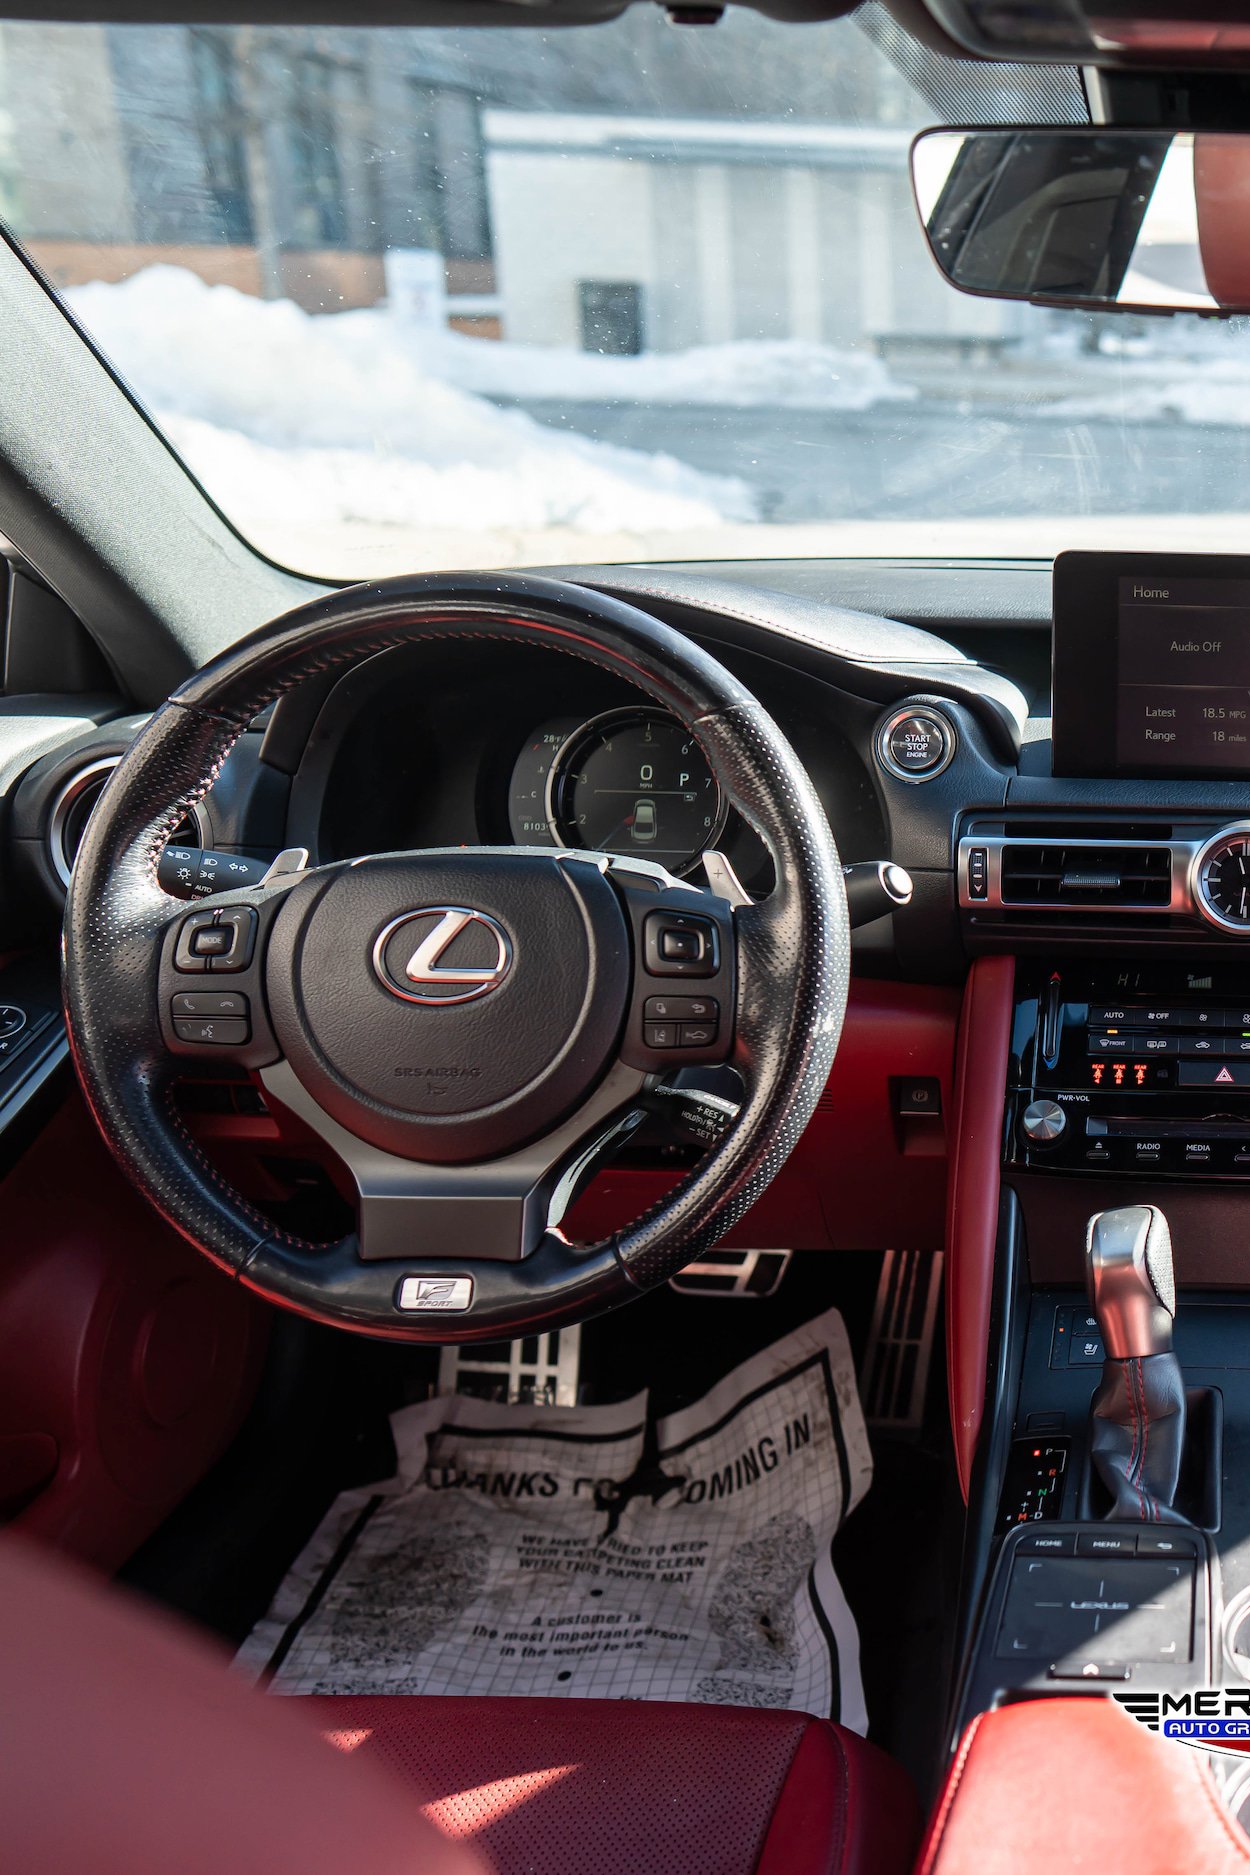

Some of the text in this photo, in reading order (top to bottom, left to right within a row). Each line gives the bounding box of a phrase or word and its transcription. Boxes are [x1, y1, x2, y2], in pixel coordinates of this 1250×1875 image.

[1133, 585, 1169, 598] Home
[1170, 641, 1221, 652] Audio Off
[1145, 706, 1247, 719] Latest 18.5 MPG
[645, 732, 652, 742] 5
[905, 734, 931, 743] START
[1145, 729, 1247, 743] Range 18 miles
[605, 742, 613, 752] 4
[681, 744, 689, 755] 6
[907, 742, 928, 751] STOP
[581, 774, 588, 785] 3
[680, 773, 689, 787] P
[704, 778, 712, 788] 7
[580, 814, 586, 825] 2
[703, 817, 711, 827] 8
[523, 822, 549, 831] 8103
[195, 884, 213, 894] AUTO
[203, 936, 222, 944] MODE
[1156, 1012, 1169, 1020] OFF
[394, 1067, 482, 1077] SRS AIRBAG
[1186, 1144, 1210, 1152] MEDIA
[1046, 1448, 1053, 1456] P
[684, 1436, 779, 1504] OMING
[784, 1413, 811, 1456] IN
[1038, 1488, 1047, 1496] N
[522, 1534, 544, 1545] WE
[602, 1536, 641, 1556] RIED
[648, 1544, 666, 1556] TO
[670, 1540, 709, 1554] KEEP
[656, 1556, 706, 1569] CLEAN
[519, 1558, 694, 1584] WITH THIS PAPER MAT
[1070, 1601, 1130, 1610] LEXUS
[531, 1612, 641, 1628] A customer is
[472, 1625, 690, 1645] the most important person
[500, 1645, 516, 1657] in
[521, 1646, 547, 1658] the
[552, 1642, 599, 1656] world
[603, 1641, 619, 1652] to
